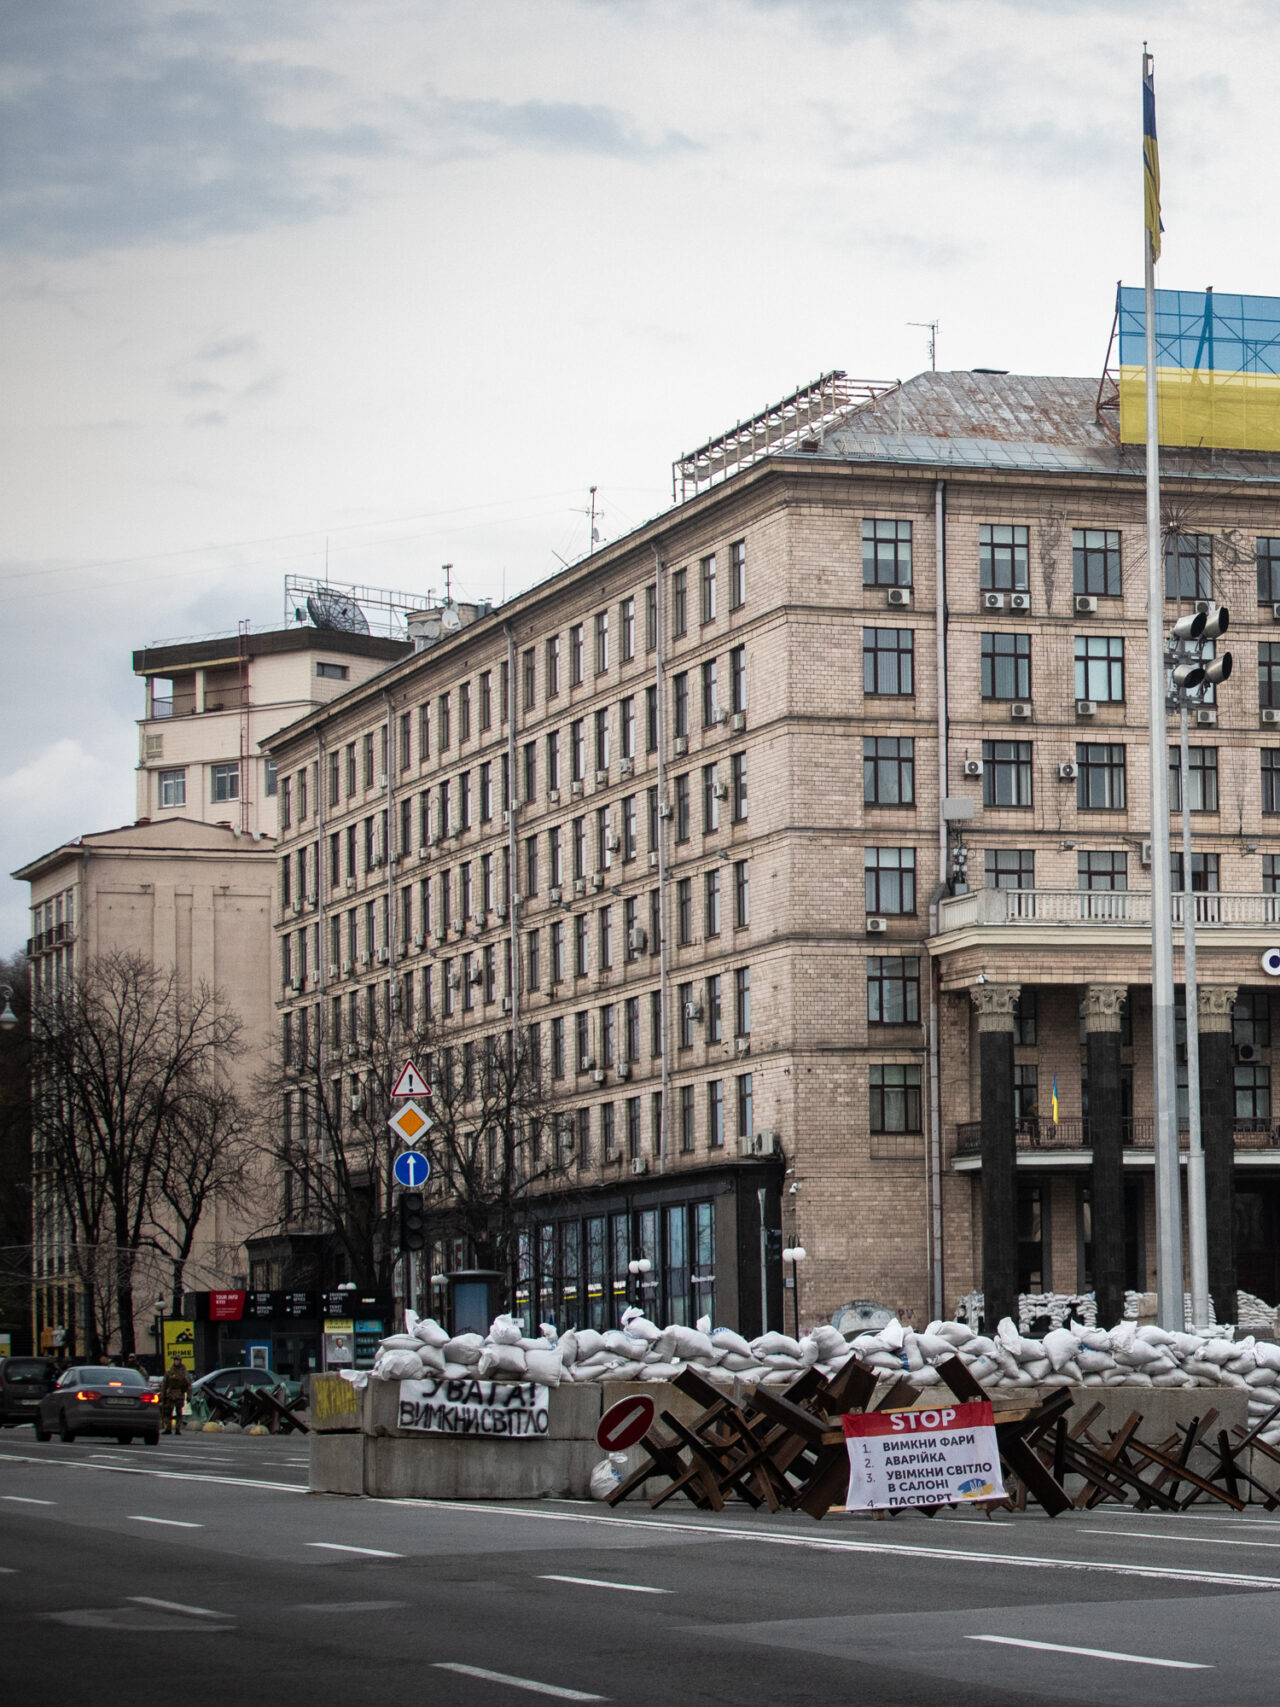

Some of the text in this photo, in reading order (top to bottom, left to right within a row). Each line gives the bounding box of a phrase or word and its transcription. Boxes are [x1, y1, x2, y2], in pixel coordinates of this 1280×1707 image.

[890, 1408, 956, 1431] STOP
[863, 1434, 975, 1454] 1. ВИМКНИ ФАРИ
[865, 1451, 946, 1469] 2. АВАРІЙКА
[866, 1462, 992, 1483] 3. УВІМКНИ СВІТЛО
[888, 1479, 949, 1492] В САЛОНІ
[867, 1493, 952, 1508] 4. ПАСПОРТ
